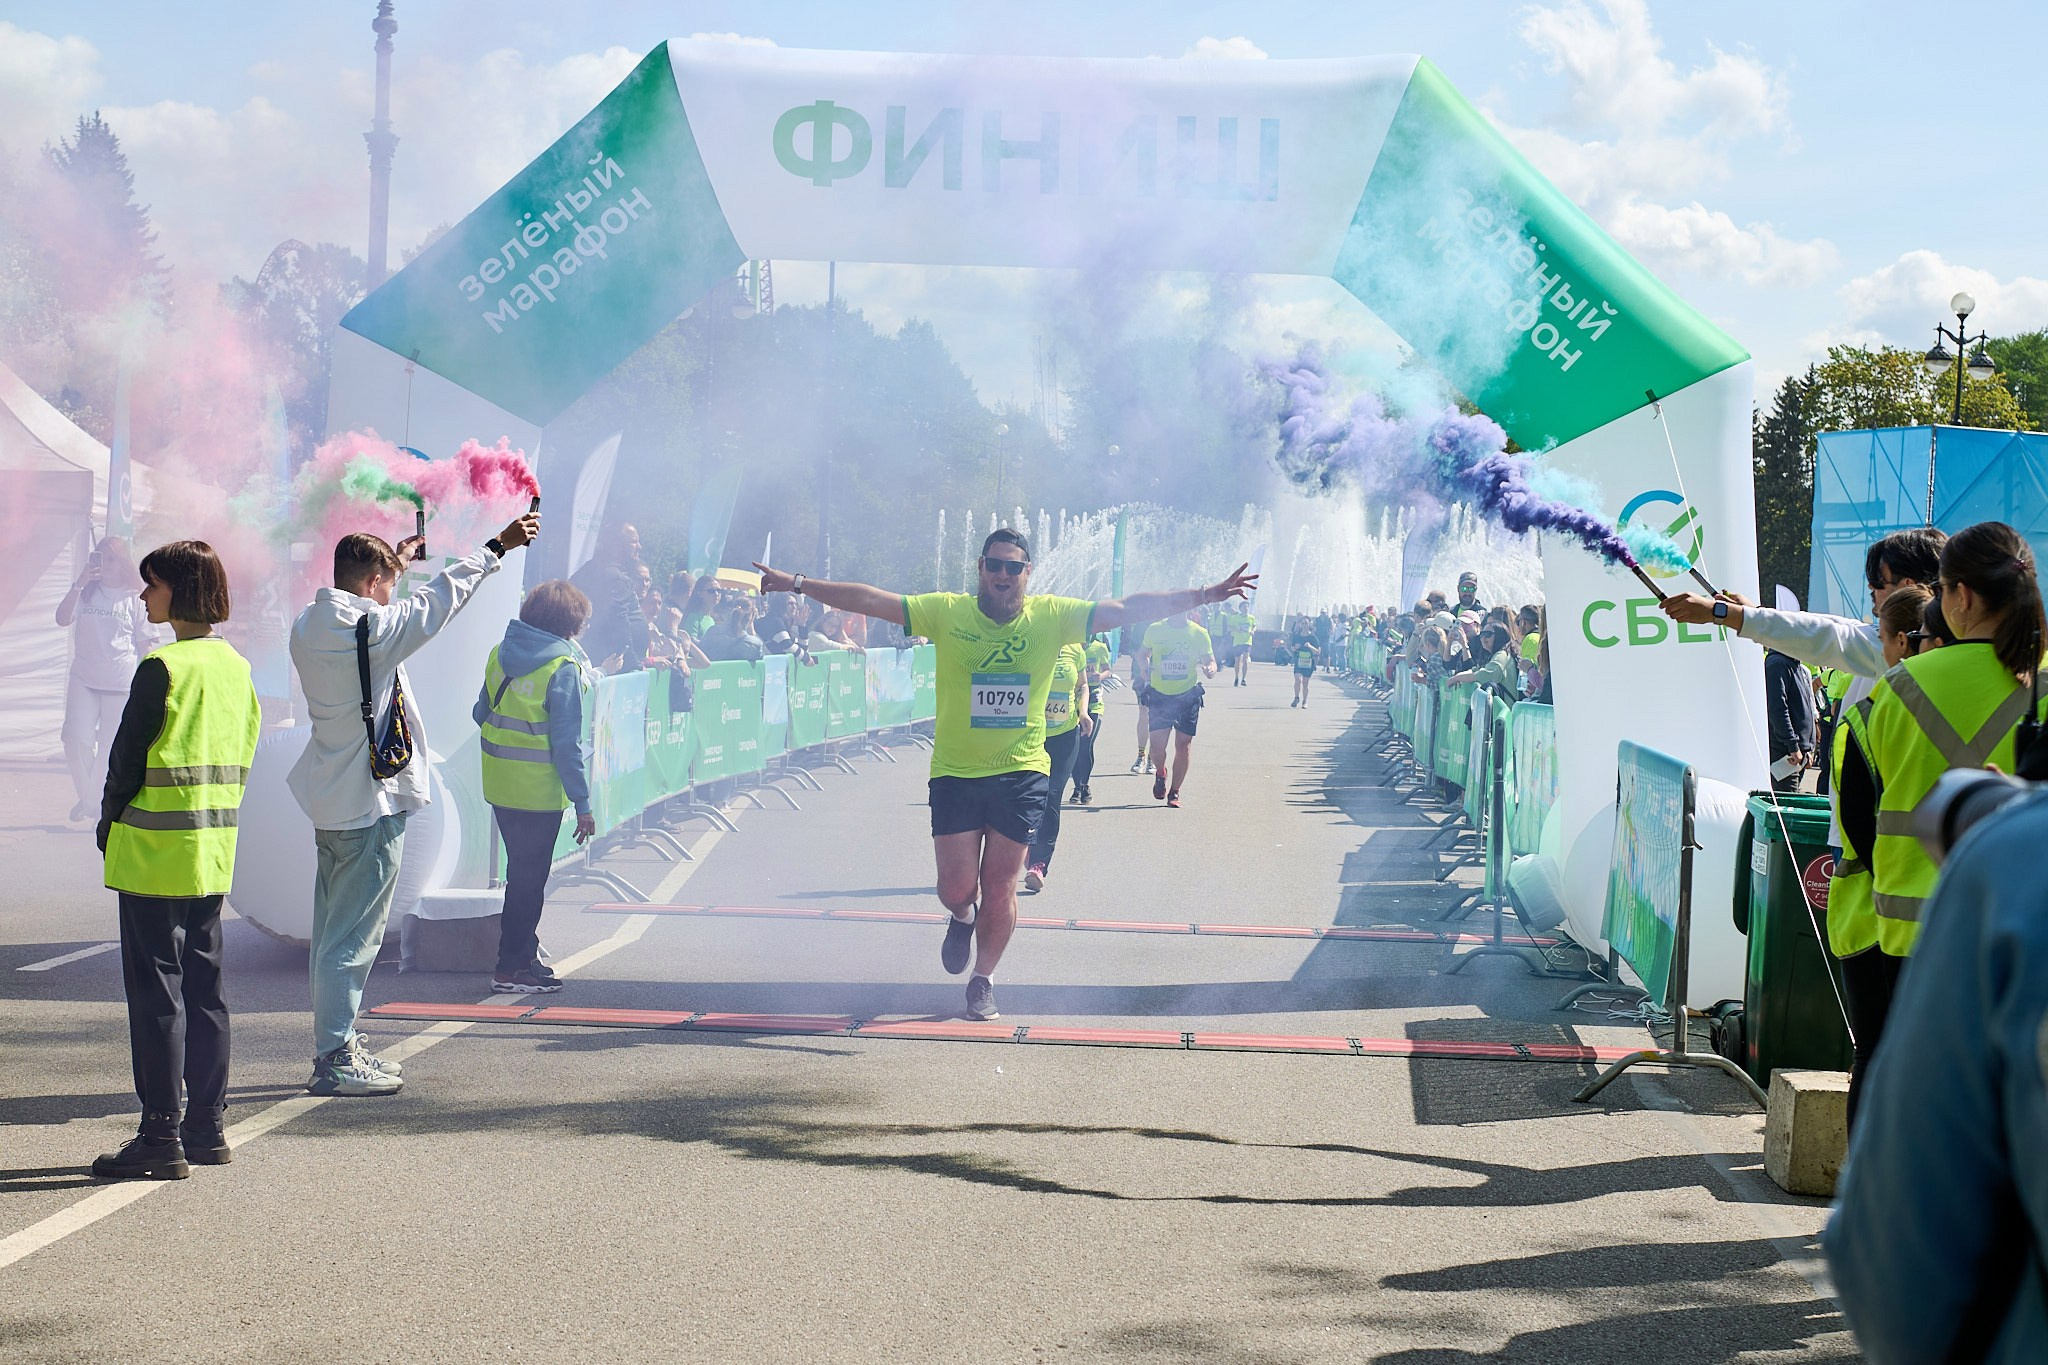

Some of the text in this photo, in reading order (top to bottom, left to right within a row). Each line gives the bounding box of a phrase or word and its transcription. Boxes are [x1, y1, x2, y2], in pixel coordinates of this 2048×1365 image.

[772, 99, 1280, 202] ФИНИШ
[458, 151, 626, 302] зелёный
[481, 186, 653, 334] марафон
[1452, 187, 1619, 342] зелёный
[1416, 215, 1584, 373] марафон
[1582, 597, 1728, 648] СБ
[977, 690, 1025, 706] 10796
[1163, 662, 1187, 671] 10826
[1045, 703, 1066, 714] 464
[1807, 880, 1830, 888] CleanD
